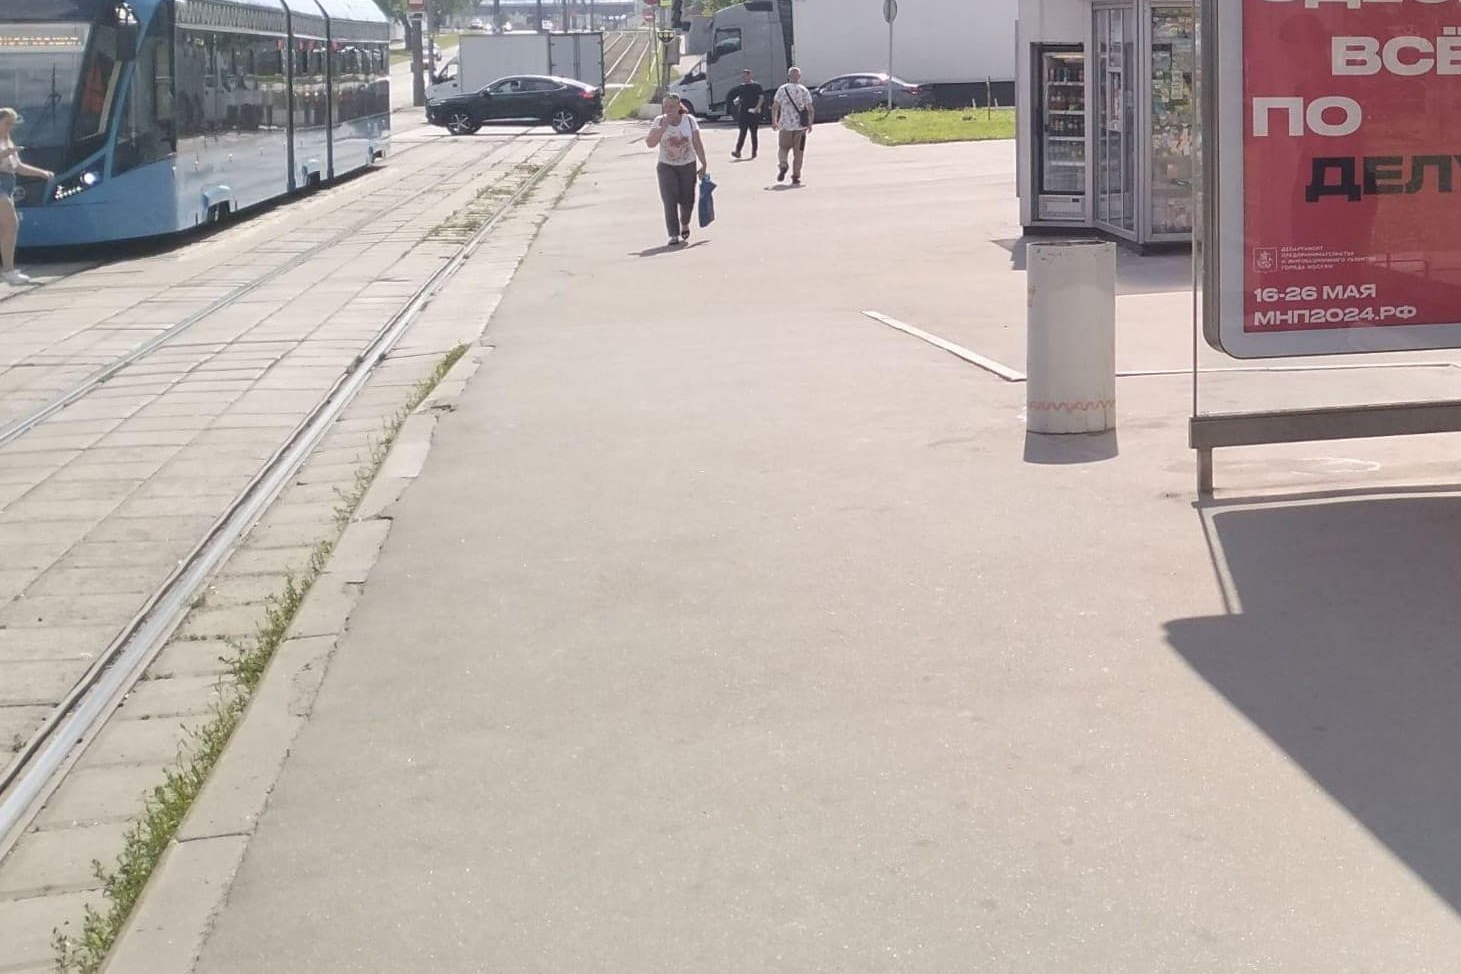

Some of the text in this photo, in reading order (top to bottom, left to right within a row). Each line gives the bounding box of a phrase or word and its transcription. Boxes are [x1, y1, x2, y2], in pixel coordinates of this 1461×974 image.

[1252, 95, 1363, 138] ПО
[1253, 283, 1377, 303] 16-26 МАЯ
[1254, 305, 1417, 326] МНП2024.РФ
